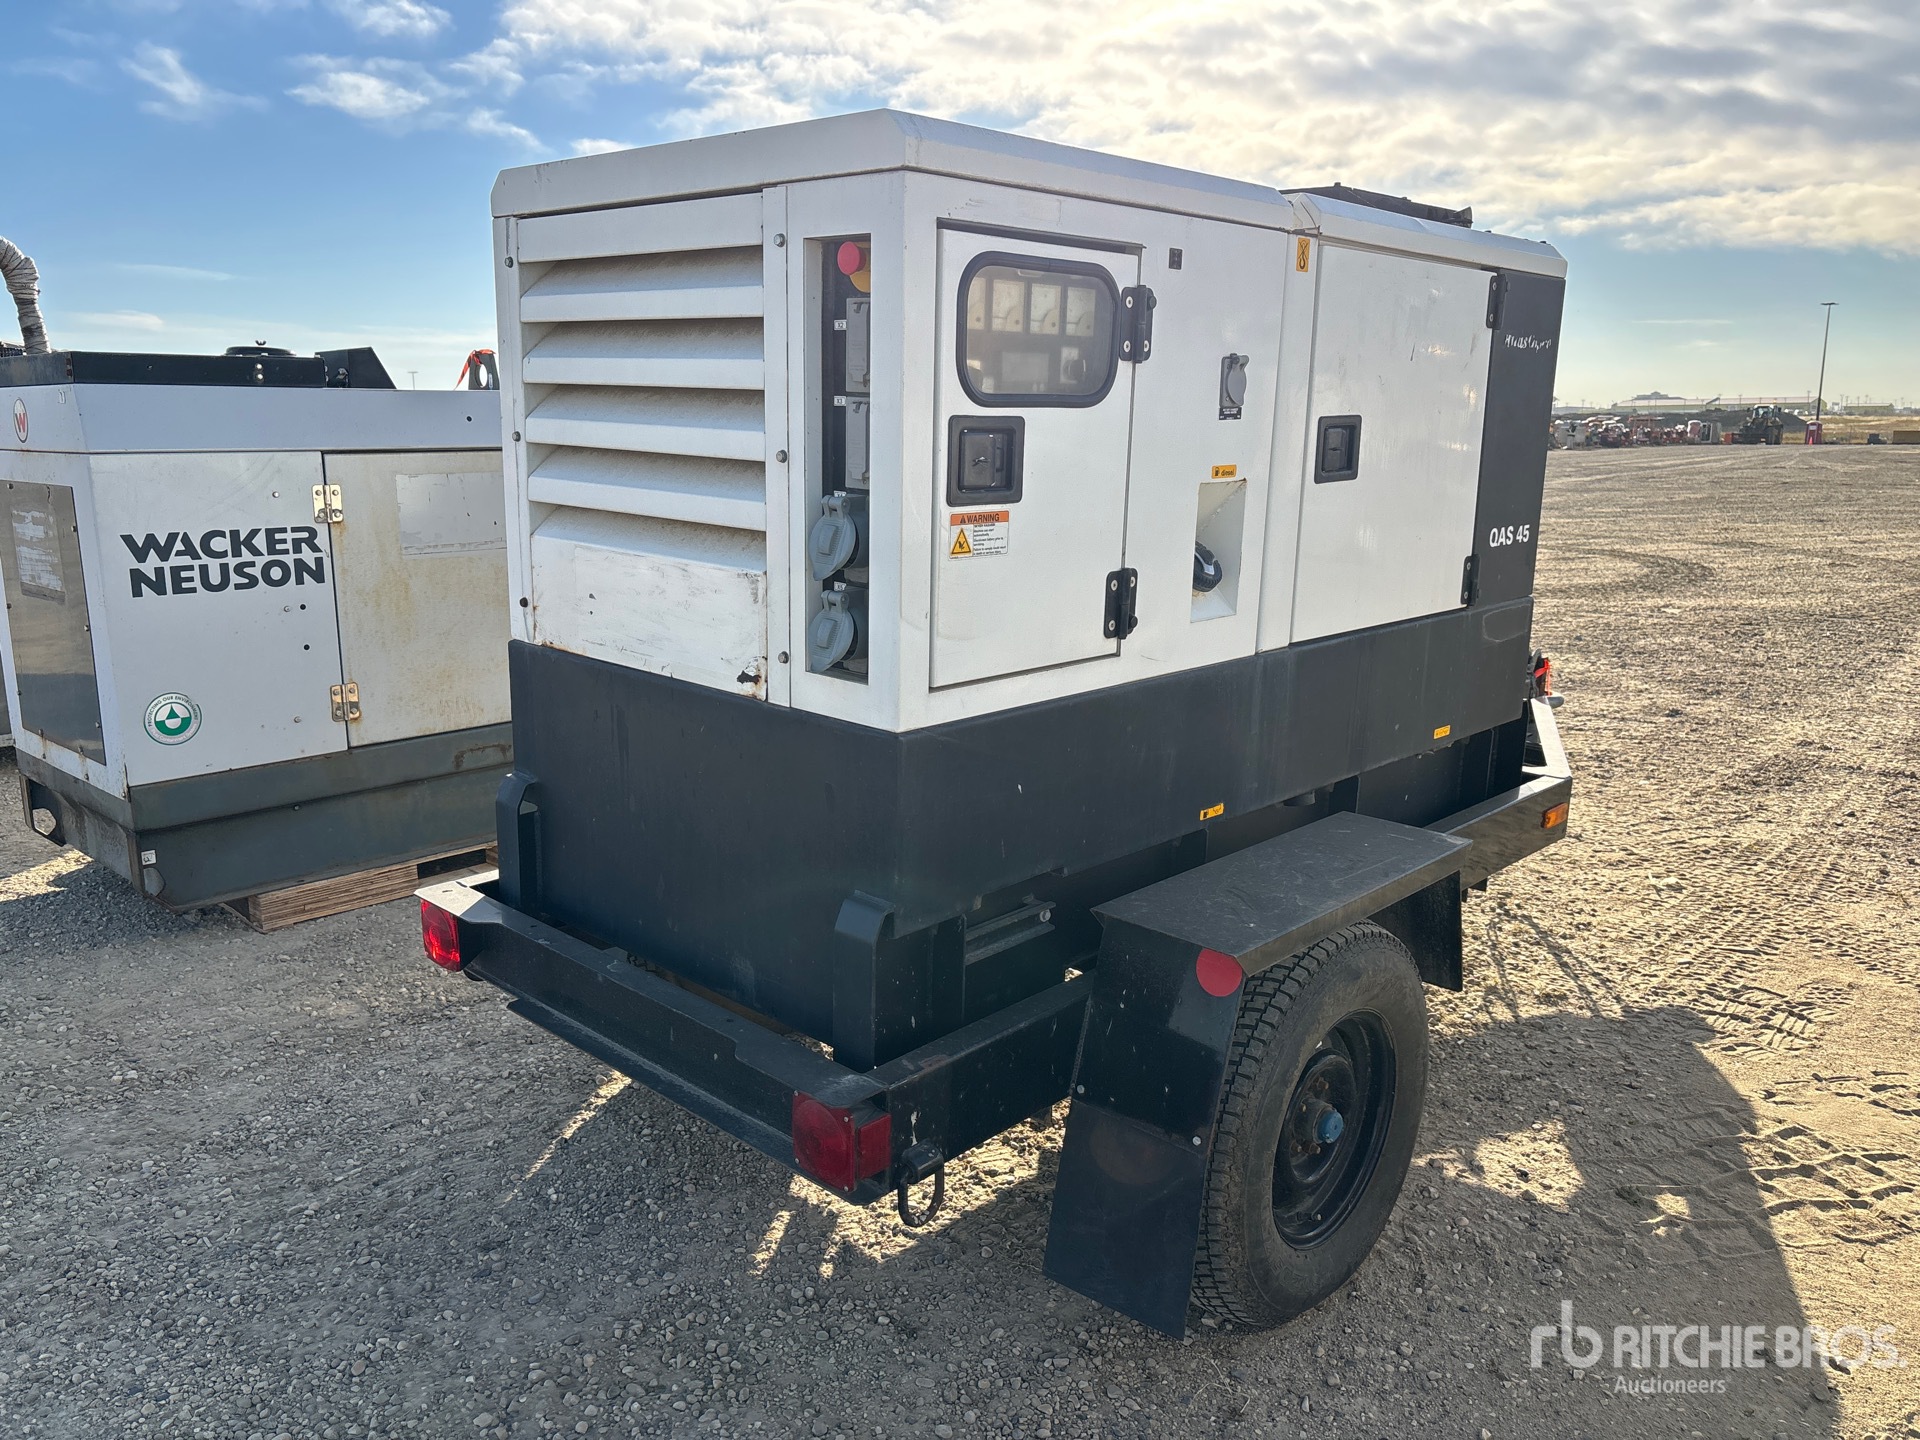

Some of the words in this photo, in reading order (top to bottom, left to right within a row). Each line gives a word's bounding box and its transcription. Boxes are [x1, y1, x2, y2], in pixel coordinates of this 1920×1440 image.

[966, 513, 1000, 524] WARNING
[120, 525, 323, 564] WACKER
[1489, 526, 1514, 548] QAS
[1516, 524, 1530, 543] 45
[129, 557, 326, 598] NEUSON
[147, 699, 163, 727] PROTECTING
[175, 695, 199, 721] ENVIRONMENT
